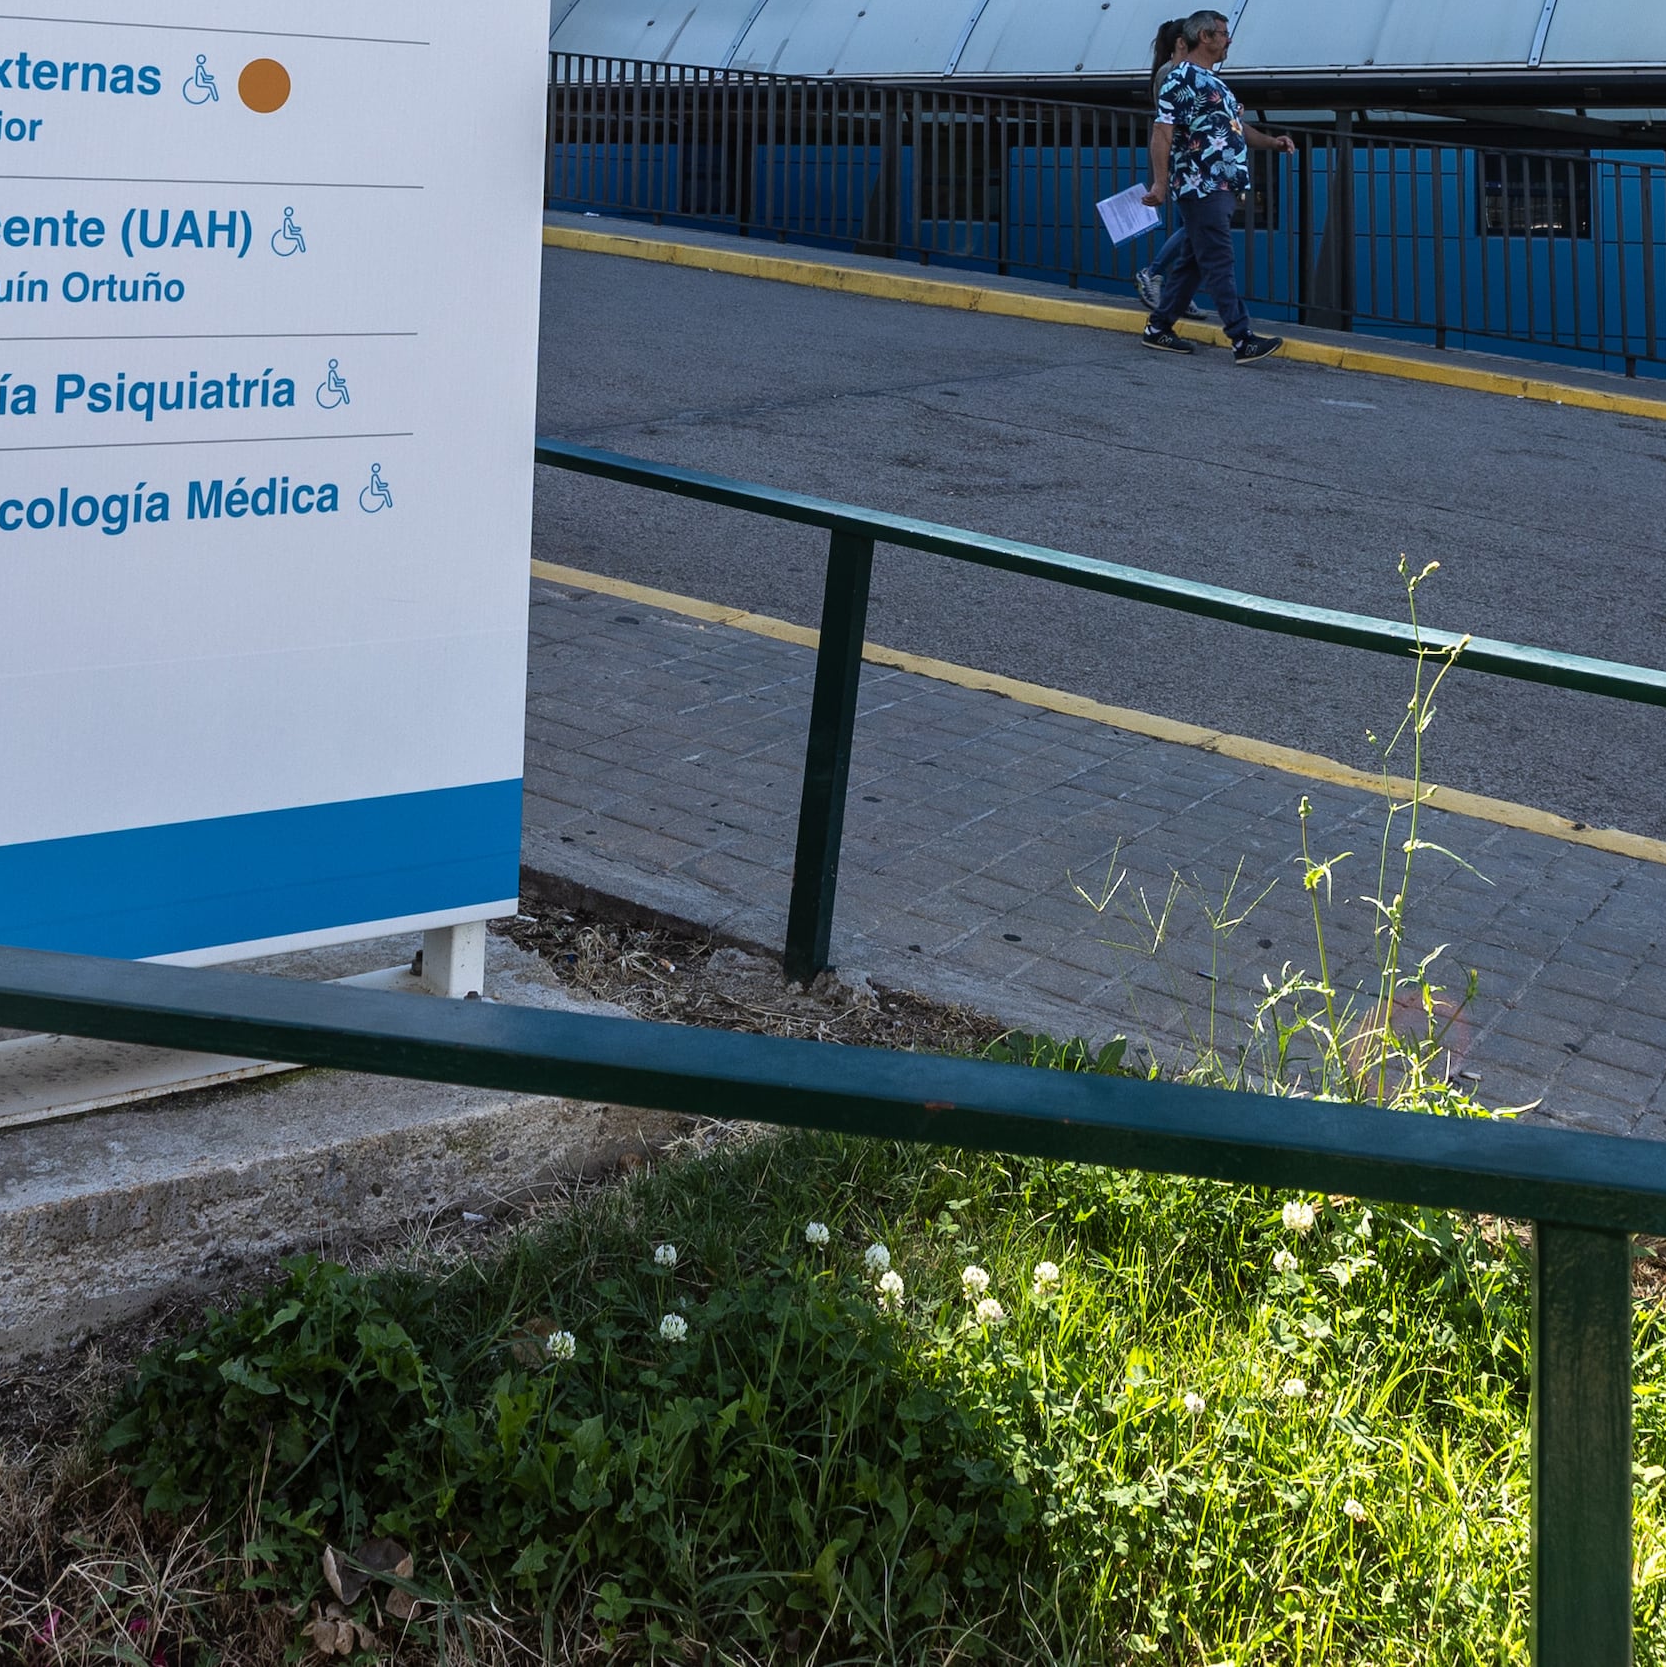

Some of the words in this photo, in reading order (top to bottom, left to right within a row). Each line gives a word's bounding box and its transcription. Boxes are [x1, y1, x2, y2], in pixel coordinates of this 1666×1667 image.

[121, 208, 252, 258] (UAH)
[62, 270, 185, 303] Ortuño
[55, 370, 295, 422] Psiquiatría
[187, 476, 338, 520] Médica
